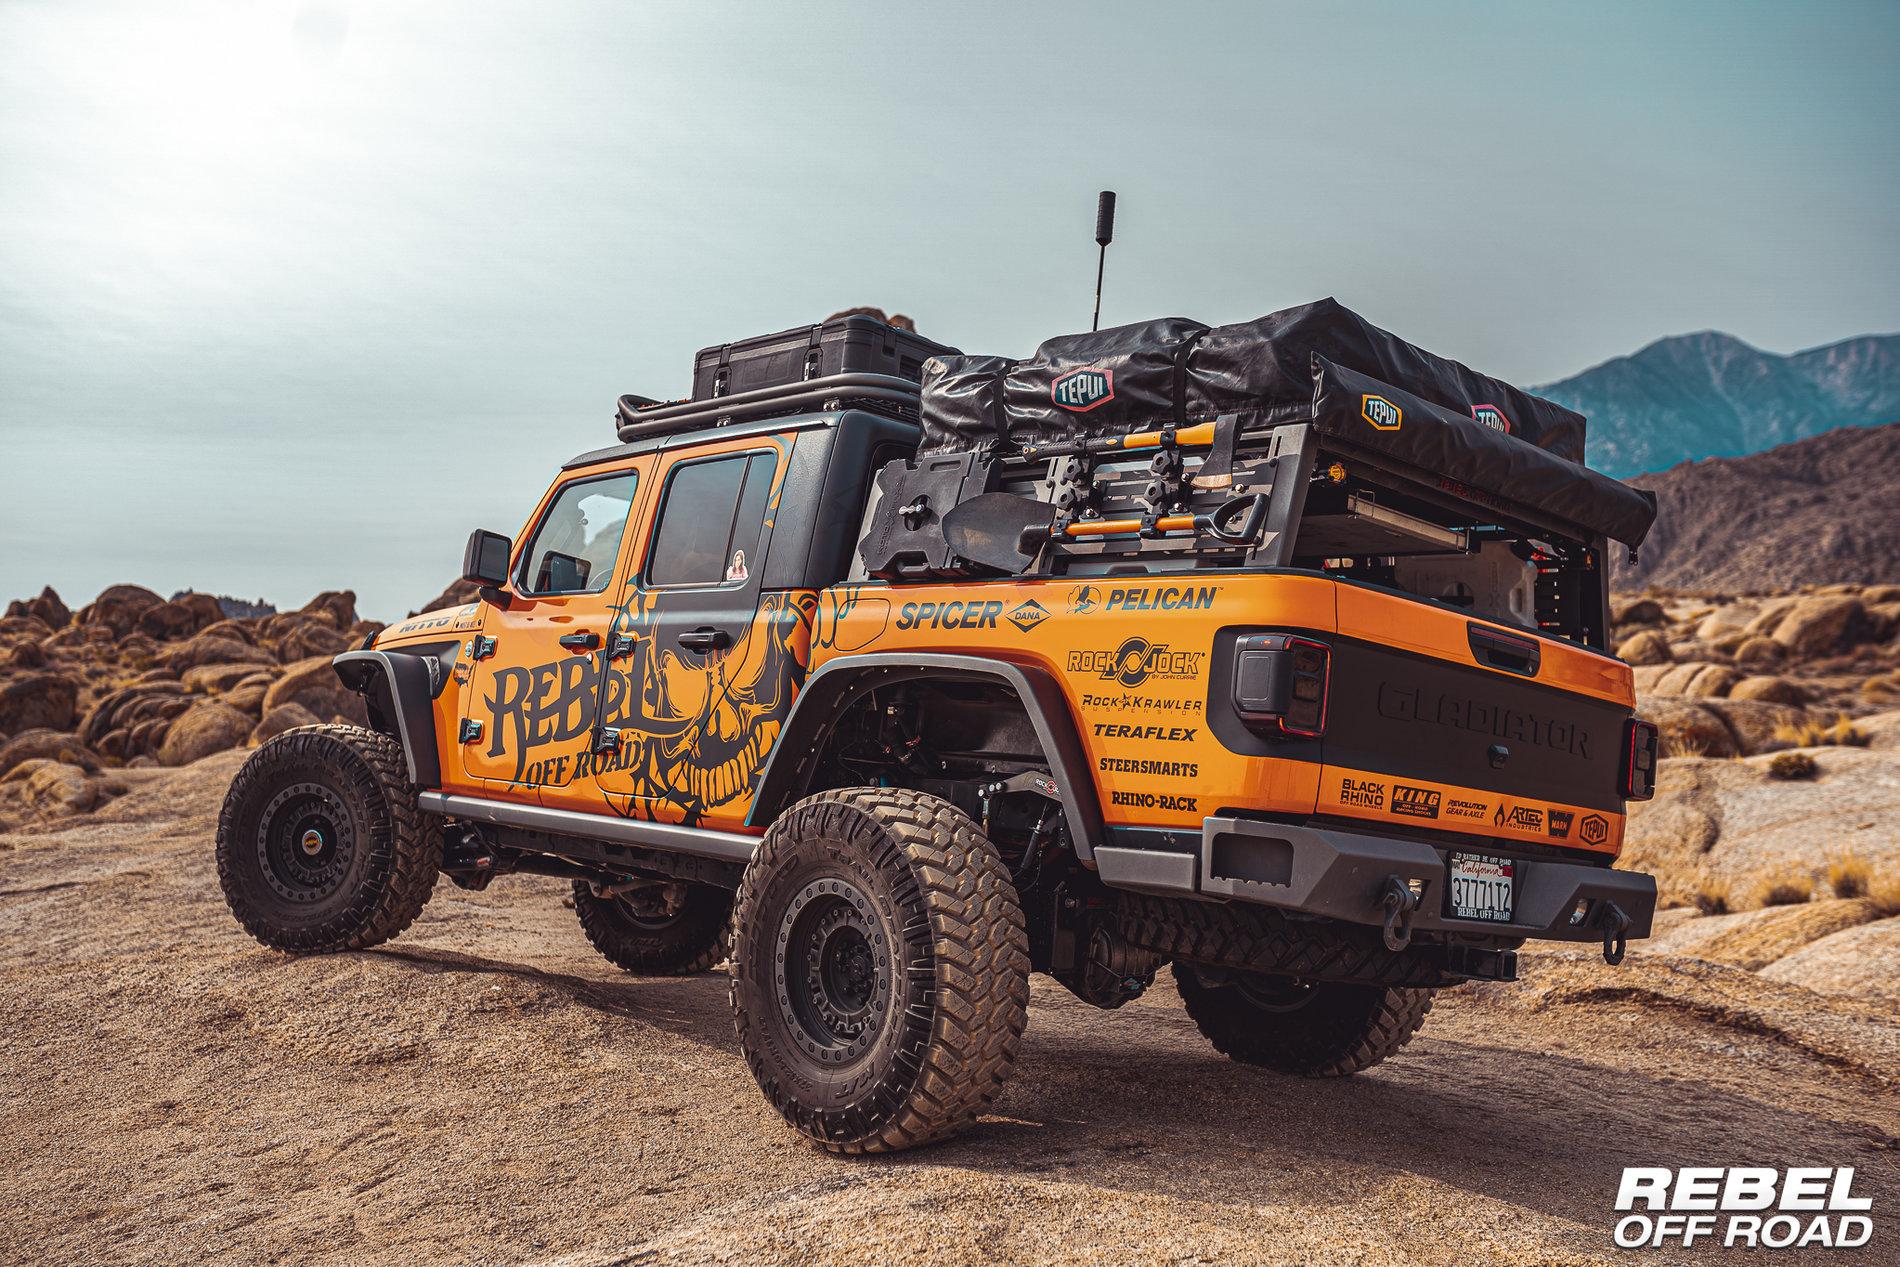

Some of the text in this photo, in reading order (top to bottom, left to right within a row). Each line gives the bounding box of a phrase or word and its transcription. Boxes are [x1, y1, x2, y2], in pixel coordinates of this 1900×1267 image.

[1059, 374, 1103, 404] TEPUI
[1368, 400, 1397, 424] TEPUI
[1105, 586, 1217, 611] PELICAN
[895, 600, 1003, 630] SPICER
[1014, 611, 1041, 620] DANA
[1067, 647, 1201, 675] ROCK JOCK
[1082, 694, 1202, 710] ROCK KRAWLER
[1377, 681, 1593, 760] GLADIATOR
[1093, 723, 1198, 742] TERAFLEX
[526, 739, 644, 790] OFF ROAD
[1100, 757, 1199, 778] STEERSMARTS
[1342, 778, 1386, 795] BLACK
[1394, 787, 1440, 806] KING
[1112, 791, 1198, 812] RHINO-RACK
[1340, 790, 1384, 806] RHINO
[1447, 799, 1488, 811] REVOLUTION
[1446, 807, 1486, 819] GEAR & AXLE
[1507, 805, 1544, 826] ARTEC
[1506, 822, 1542, 832] INDUSTRIES
[1584, 818, 1604, 840] TEPUI
[1461, 860, 1503, 878] California
[1458, 906, 1511, 921] REBEL OFF ROAD
